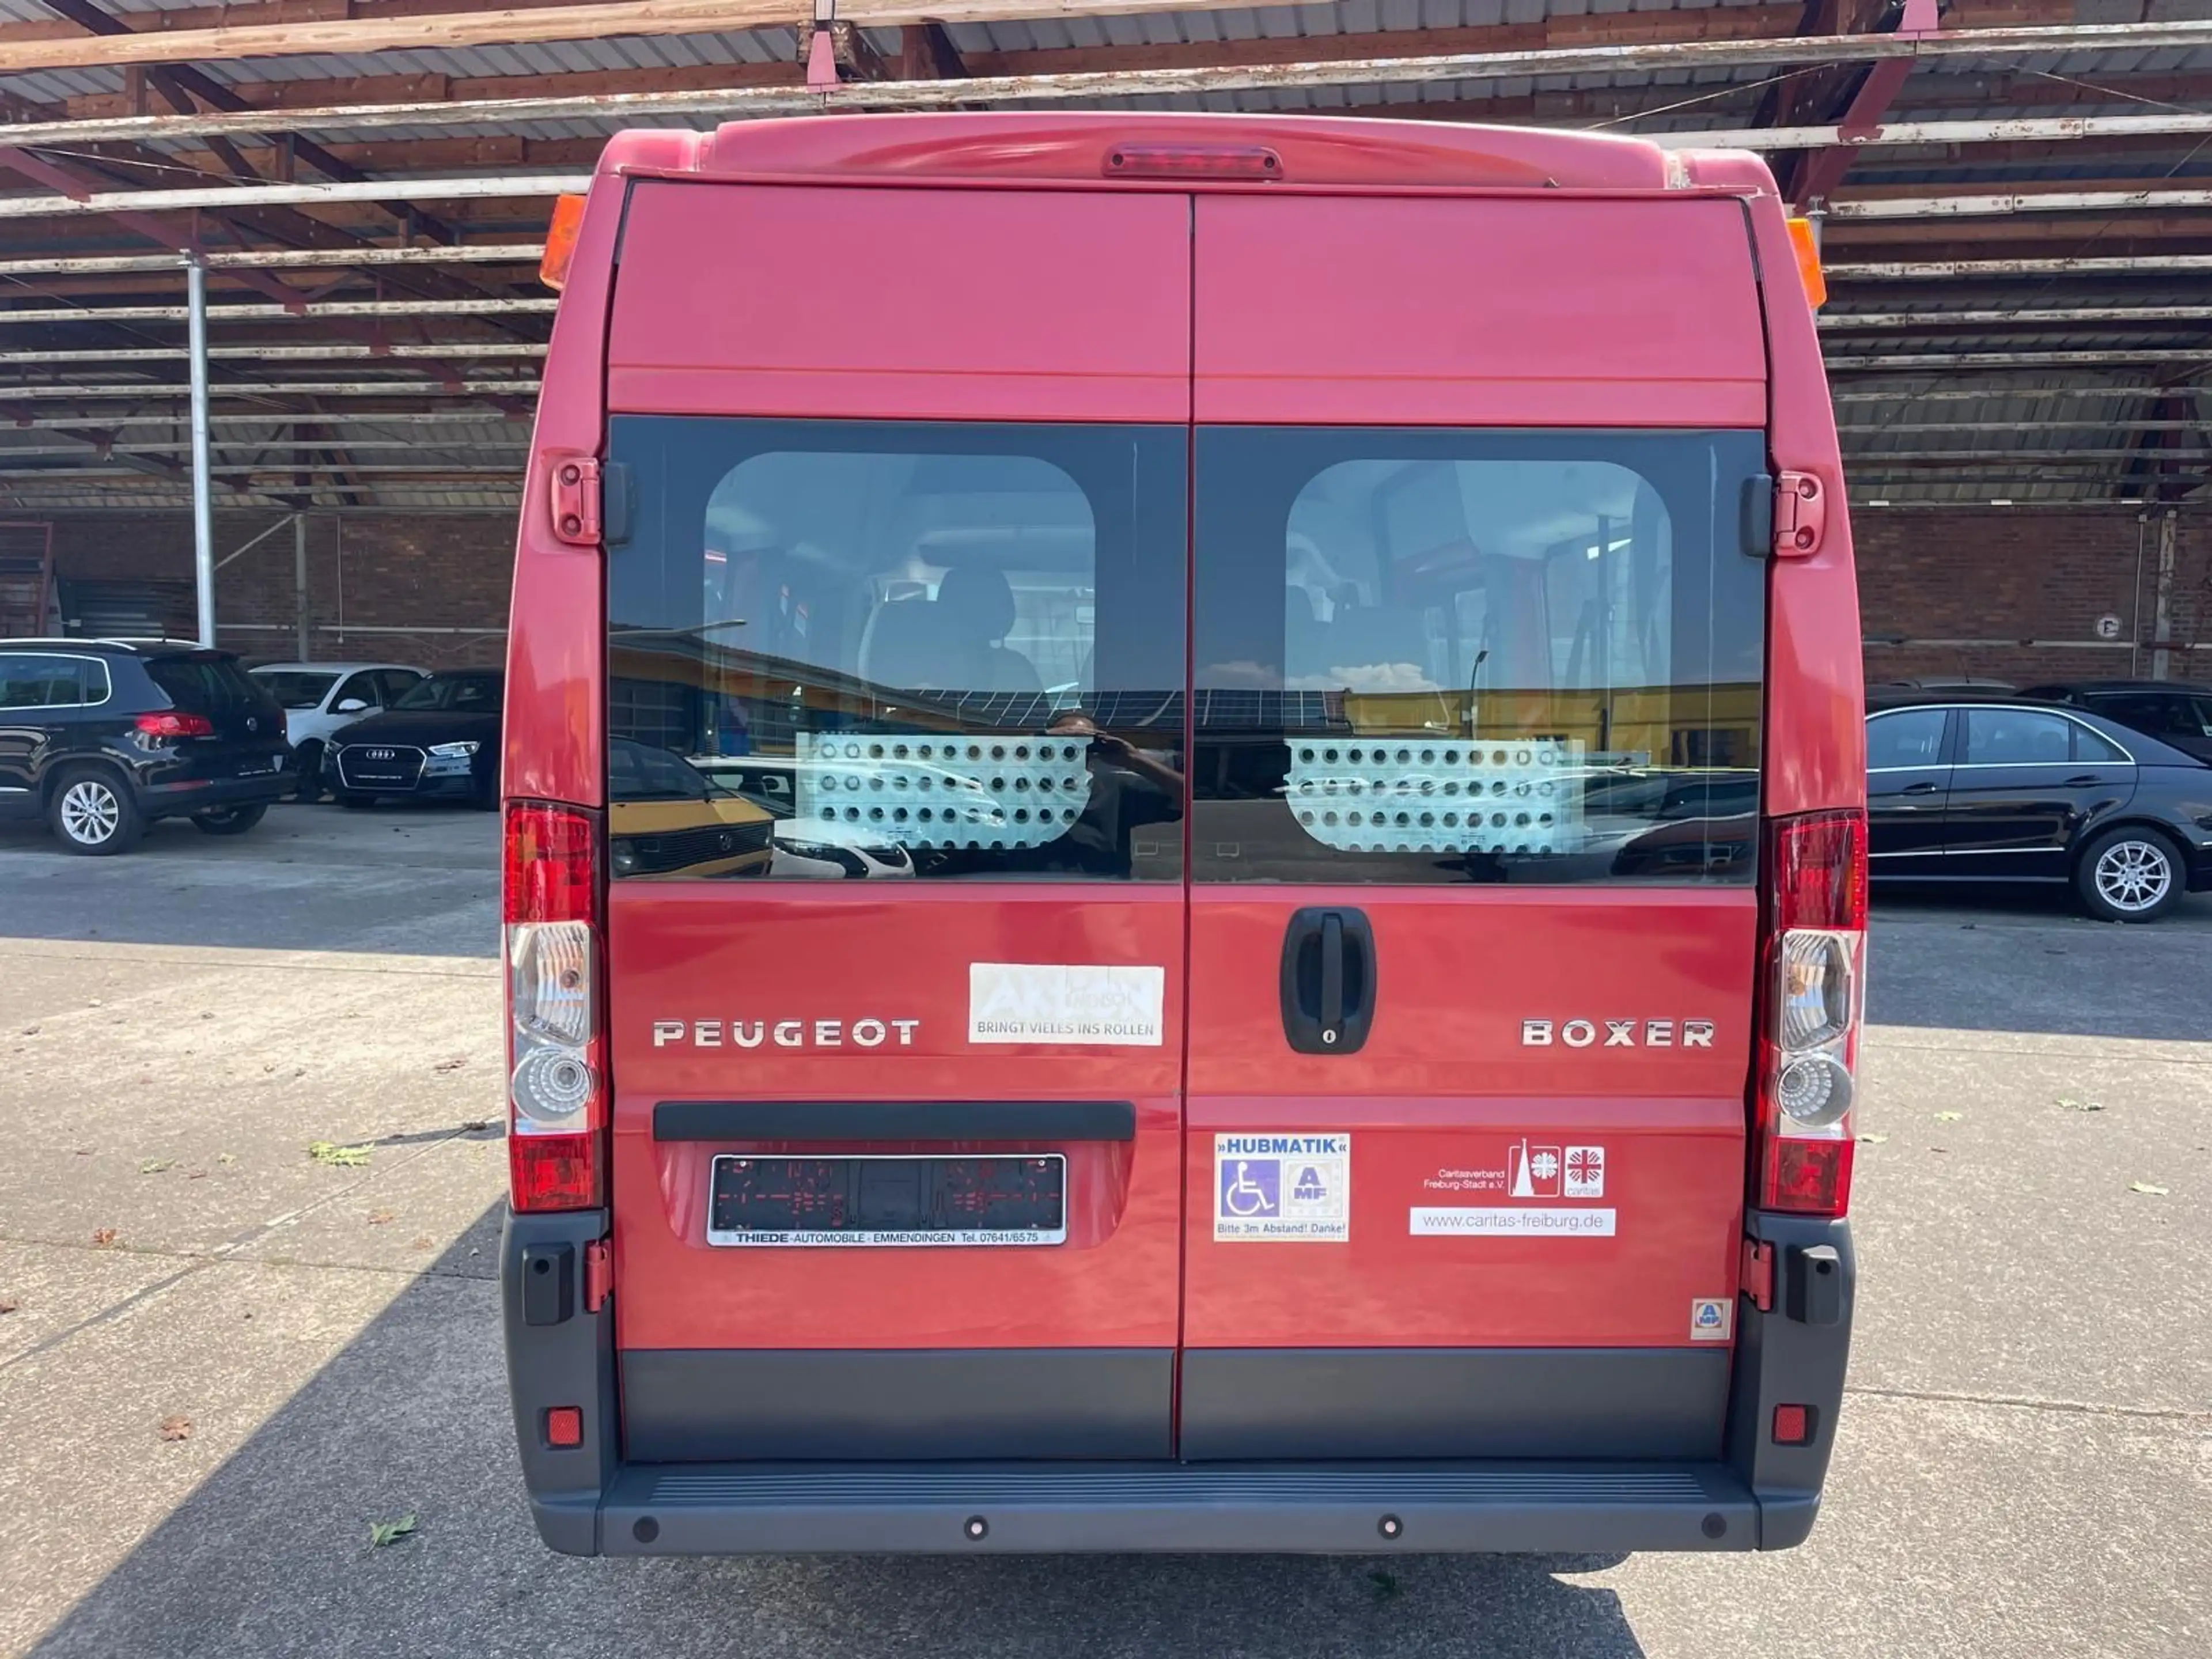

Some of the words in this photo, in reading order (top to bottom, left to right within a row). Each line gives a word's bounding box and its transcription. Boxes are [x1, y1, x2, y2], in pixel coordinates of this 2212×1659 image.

[653, 1018, 920, 1048] PEUGEOT
[978, 1021, 1025, 1033] BRINGT
[1030, 1022, 1074, 1035] VIELES
[1078, 1022, 1100, 1035] INS
[1104, 1022, 1154, 1035] ROLLEN
[1522, 1019, 1715, 1048] BOXER
[1567, 1187, 1600, 1196] caritas
[1218, 1224, 1241, 1233] Bitte
[1263, 1224, 1308, 1233] Abstand!
[1311, 1224, 1346, 1233] Danke!
[1423, 1214, 1604, 1230] www.caritas-freiburg.de
[873, 1233, 955, 1243] EMMENDINGEN
[963, 1233, 977, 1242] Tel.
